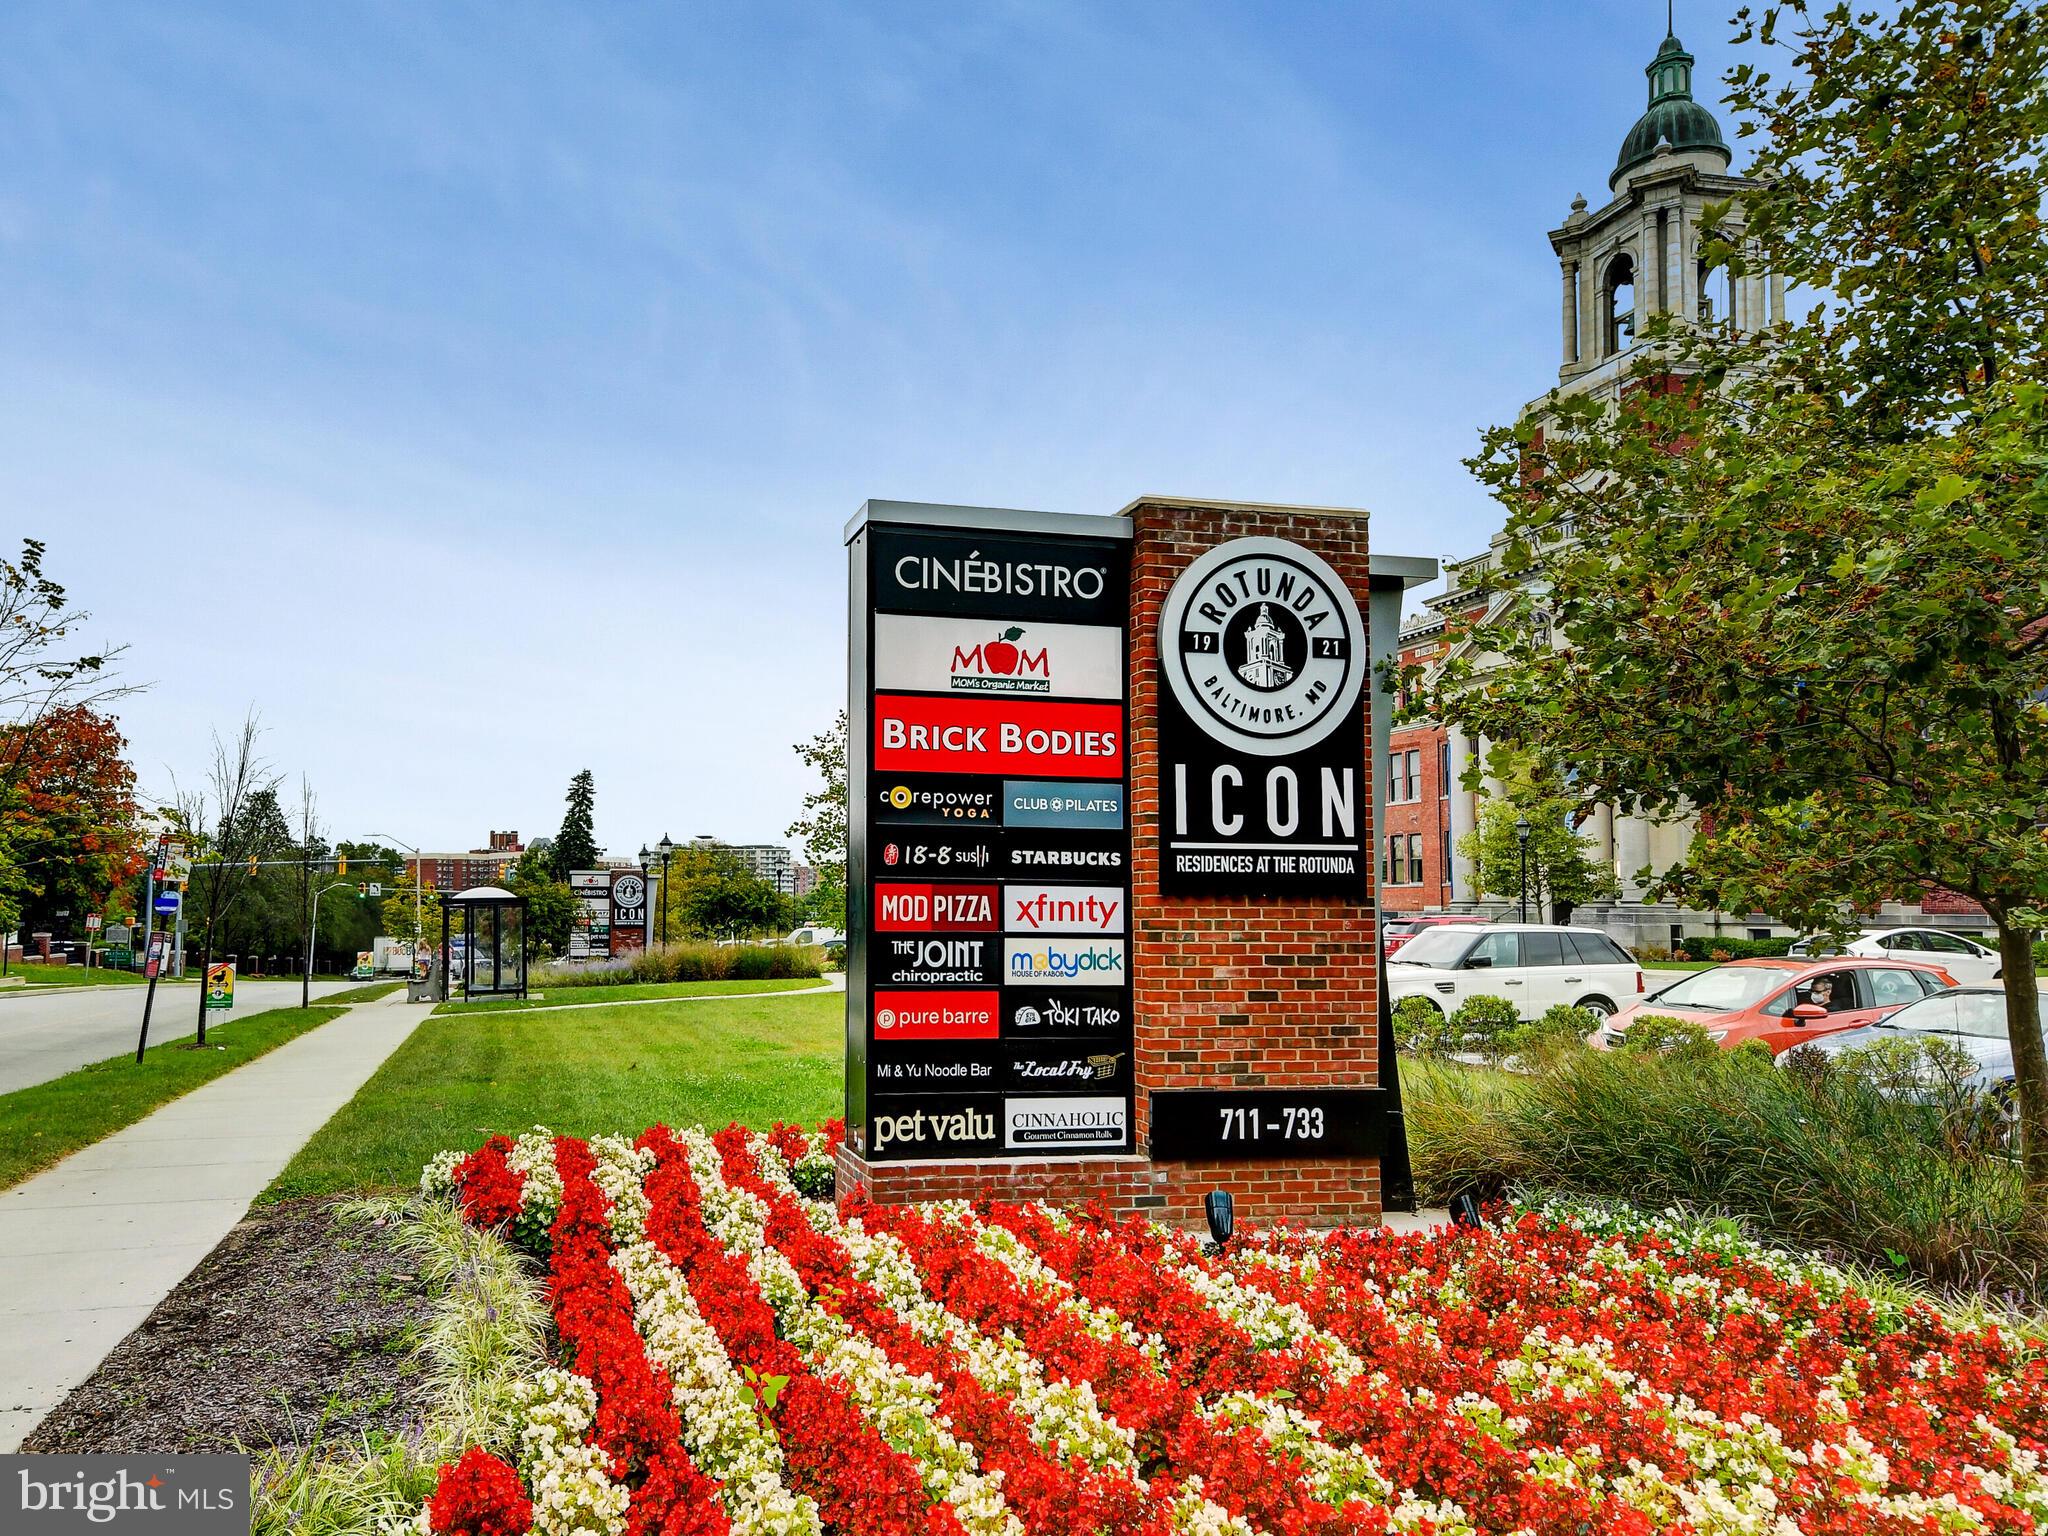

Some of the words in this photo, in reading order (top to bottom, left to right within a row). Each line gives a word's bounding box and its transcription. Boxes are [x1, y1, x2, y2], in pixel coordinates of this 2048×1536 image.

[1199, 567, 1330, 631] ROTUNDA
[1193, 633, 1211, 651] 19
[1322, 640, 1339, 656] 21
[952, 678, 980, 688] MOM's
[981, 680, 1015, 691] Organic
[1016, 681, 1049, 692] Market
[1305, 680, 1327, 705] MD
[880, 786, 993, 809] corepower
[1014, 797, 1048, 810] CLUB
[1065, 799, 1118, 812] PILATES
[1175, 763, 1355, 837] ICON
[942, 808, 990, 818] YOGA
[905, 845, 952, 865] 18-8
[1011, 850, 1121, 866] STARBUCKS
[1176, 855, 1253, 873] RESIDENCES
[1256, 856, 1270, 873] AT
[1273, 856, 1296, 873] THE
[1299, 857, 1355, 874] ROTUNDA
[614, 908, 644, 920] ICON
[882, 895, 928, 922] MOD
[934, 895, 992, 922] PIZZA
[1016, 893, 1119, 928] xfinity
[891, 941, 914, 955] THE
[913, 940, 984, 968] JOINT
[892, 969, 983, 984] chiropractic
[1012, 970, 1033, 978] HOUSE
[1034, 970, 1042, 978] OF
[1043, 970, 1064, 978] KABOB
[899, 1011, 940, 1028] pure
[943, 1008, 989, 1024] barre
[1043, 998, 1079, 1026] TOKI
[1082, 1006, 1120, 1026] TAKO
[877, 1064, 891, 1077] Mi
[894, 1065, 903, 1077] &
[905, 1064, 921, 1077] Yu
[924, 1063, 968, 1077] Noodle
[971, 1064, 992, 1077] Bar
[1021, 1060, 1068, 1077] Local
[1066, 1060, 1094, 1079] Fry
[874, 1110, 926, 1151] pet
[928, 1107, 996, 1141] valu
[1012, 1112, 1124, 1127] CINNAHOLIC
[1023, 1132, 1056, 1141] Gourmet
[1057, 1131, 1094, 1140] Cinnamon
[1095, 1130, 1113, 1139] Rolls
